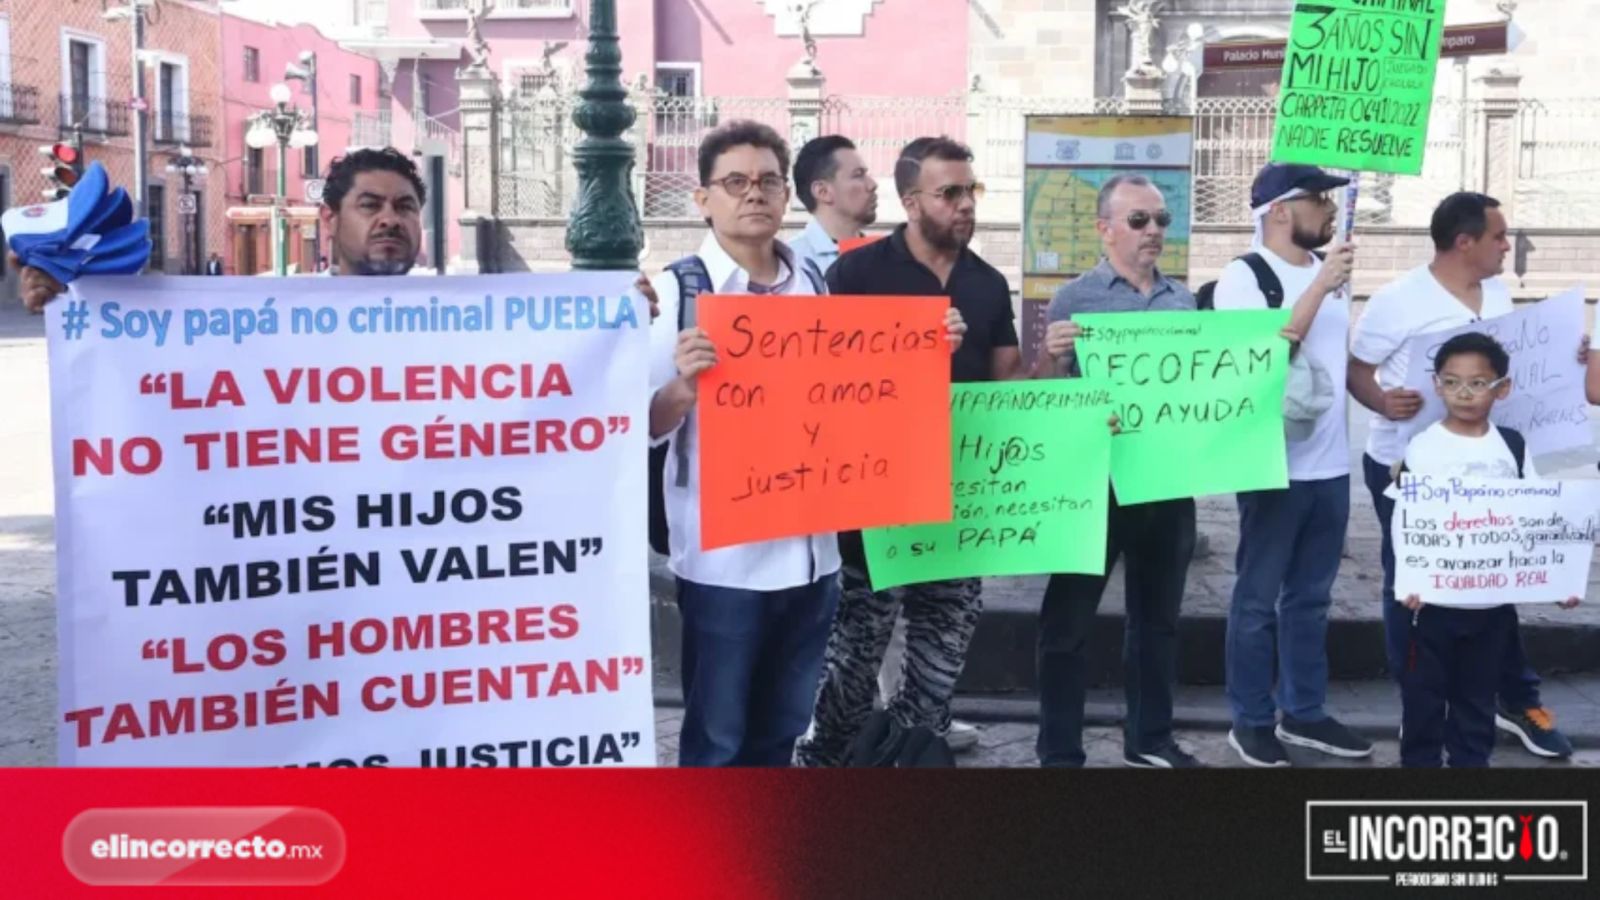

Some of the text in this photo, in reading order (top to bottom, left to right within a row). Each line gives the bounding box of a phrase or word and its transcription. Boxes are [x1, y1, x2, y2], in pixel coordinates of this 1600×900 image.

[1293, 4, 1432, 60] 3 AÑOS SIN
[1441, 35, 1476, 50] mparo
[1223, 49, 1259, 62] Palacio
[1287, 52, 1380, 92] MI HIJO
[1280, 92, 1347, 120] CARPETA
[1277, 125, 1415, 157] NADIE RESUELVE
[101, 301, 172, 347] Soy
[184, 297, 278, 345] papá
[291, 306, 338, 334] no
[349, 294, 493, 333] criminal
[505, 295, 639, 331] PUEBLA
[726, 314, 938, 359] Sentencias
[263, 363, 573, 405] VIOLENCIA
[1085, 347, 1272, 386] CECOFAM
[715, 382, 765, 408] con
[1155, 397, 1255, 424] AYUDA
[72, 436, 163, 477] NO
[184, 426, 361, 472] TIENE
[959, 433, 1046, 475] Hij@s
[731, 453, 889, 502] justicia
[950, 479, 1027, 497] esitan
[356, 486, 523, 529] HIJOS
[995, 496, 1093, 516] necesitan
[1402, 508, 1564, 532] Los derechos son de
[910, 541, 936, 558] su
[957, 520, 1042, 551] PAPÁ
[1402, 531, 1450, 548] TODAS
[112, 545, 381, 607] TAMBIÉN
[1405, 548, 1565, 571] es avanzar hacia la
[1428, 571, 1548, 591] IGUALDAD REAL
[307, 603, 580, 660] HOMBRES
[64, 678, 340, 749] TAMBIÉN
